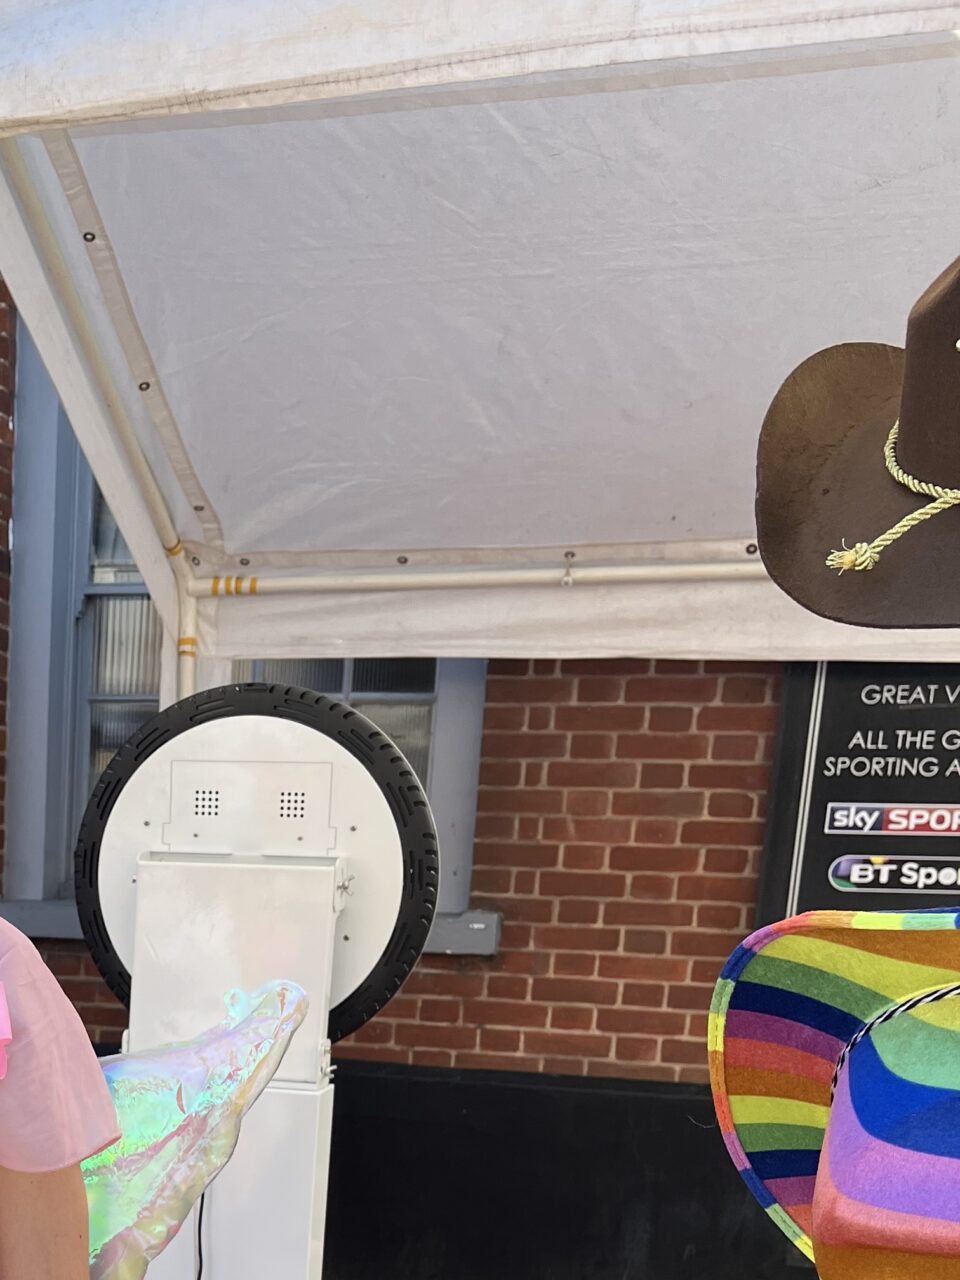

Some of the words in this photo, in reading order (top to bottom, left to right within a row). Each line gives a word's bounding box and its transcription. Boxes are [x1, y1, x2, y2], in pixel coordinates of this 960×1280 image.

[861, 684, 939, 705] GREAT
[945, 685, 960, 704] V
[848, 730, 888, 750] ALL
[895, 729, 936, 750] THE
[941, 729, 960, 751] G
[823, 756, 939, 777] SPORTING
[833, 806, 880, 832] sky
[850, 863, 897, 884] BT
[900, 862, 960, 889] Spo
